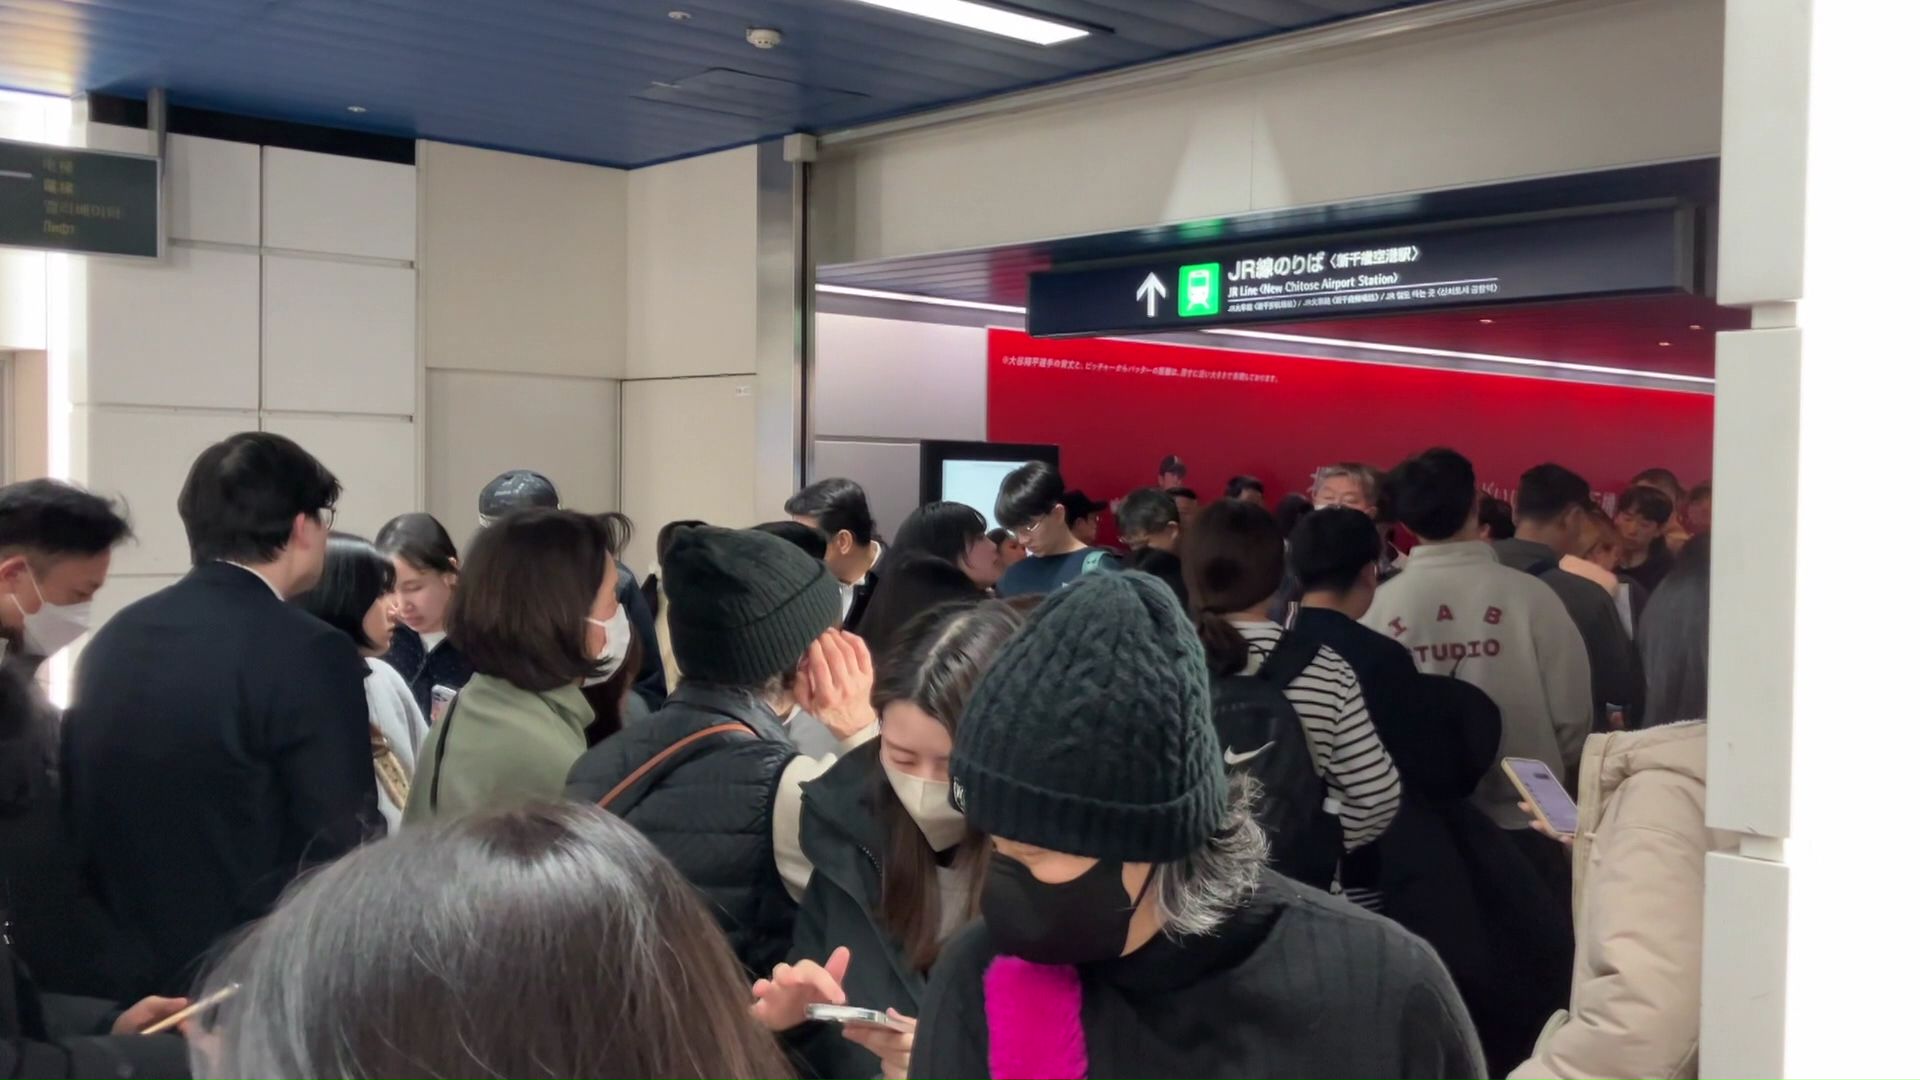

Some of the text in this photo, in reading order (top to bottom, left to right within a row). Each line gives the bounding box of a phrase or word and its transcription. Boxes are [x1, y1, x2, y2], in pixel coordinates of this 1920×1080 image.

[1228, 286, 1238, 298] JR
[1240, 284, 1258, 296] Line
[1285, 280, 1319, 292] Chitose
[1321, 276, 1355, 291] Airport
